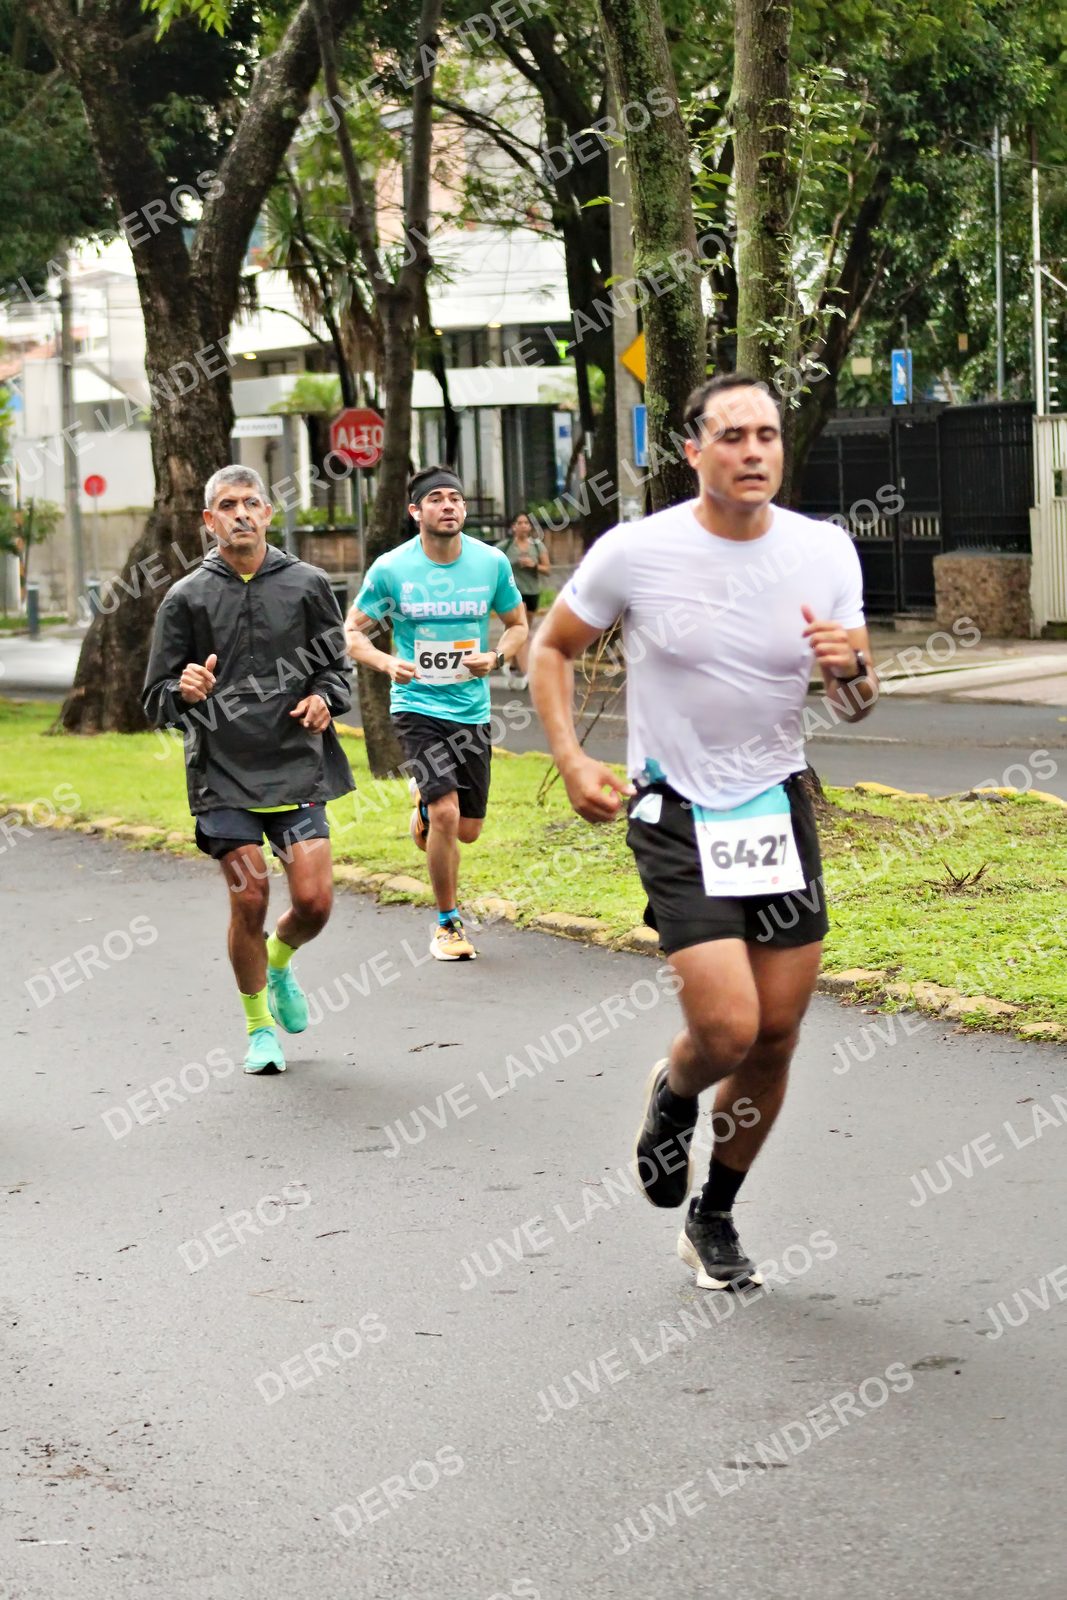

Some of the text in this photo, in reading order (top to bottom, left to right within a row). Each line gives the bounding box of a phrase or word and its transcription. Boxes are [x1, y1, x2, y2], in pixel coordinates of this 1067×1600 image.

[337, 425, 384, 449] ALTO
[400, 599, 488, 617] PERDURA
[419, 650, 473, 670] 667
